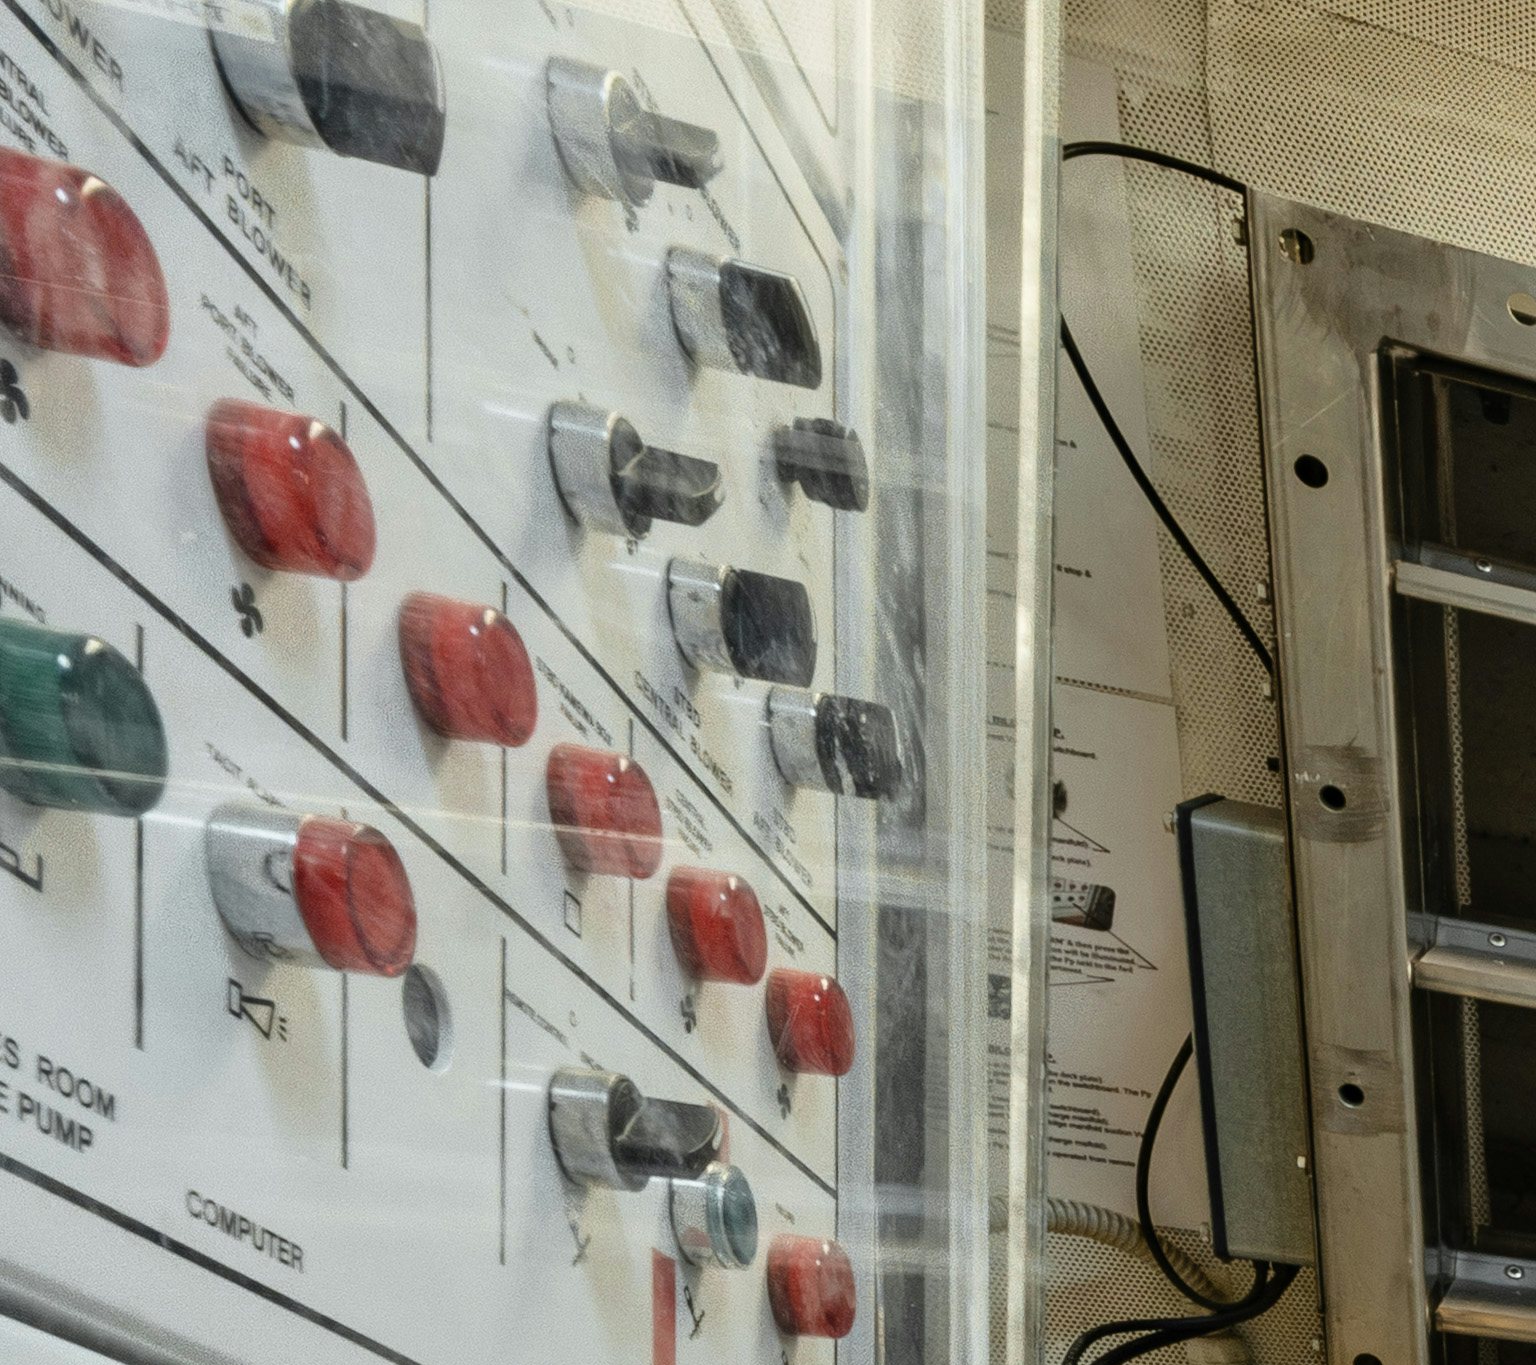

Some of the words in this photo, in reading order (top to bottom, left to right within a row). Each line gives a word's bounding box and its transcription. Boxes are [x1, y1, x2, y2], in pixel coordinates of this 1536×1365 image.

[223, 154, 276, 230] PORT
[226, 193, 312, 312] BLOWER
[16, 1090, 95, 1152] PUMP
[35, 1053, 117, 1122] ROOM
[184, 1188, 306, 1275] COMPUTER
